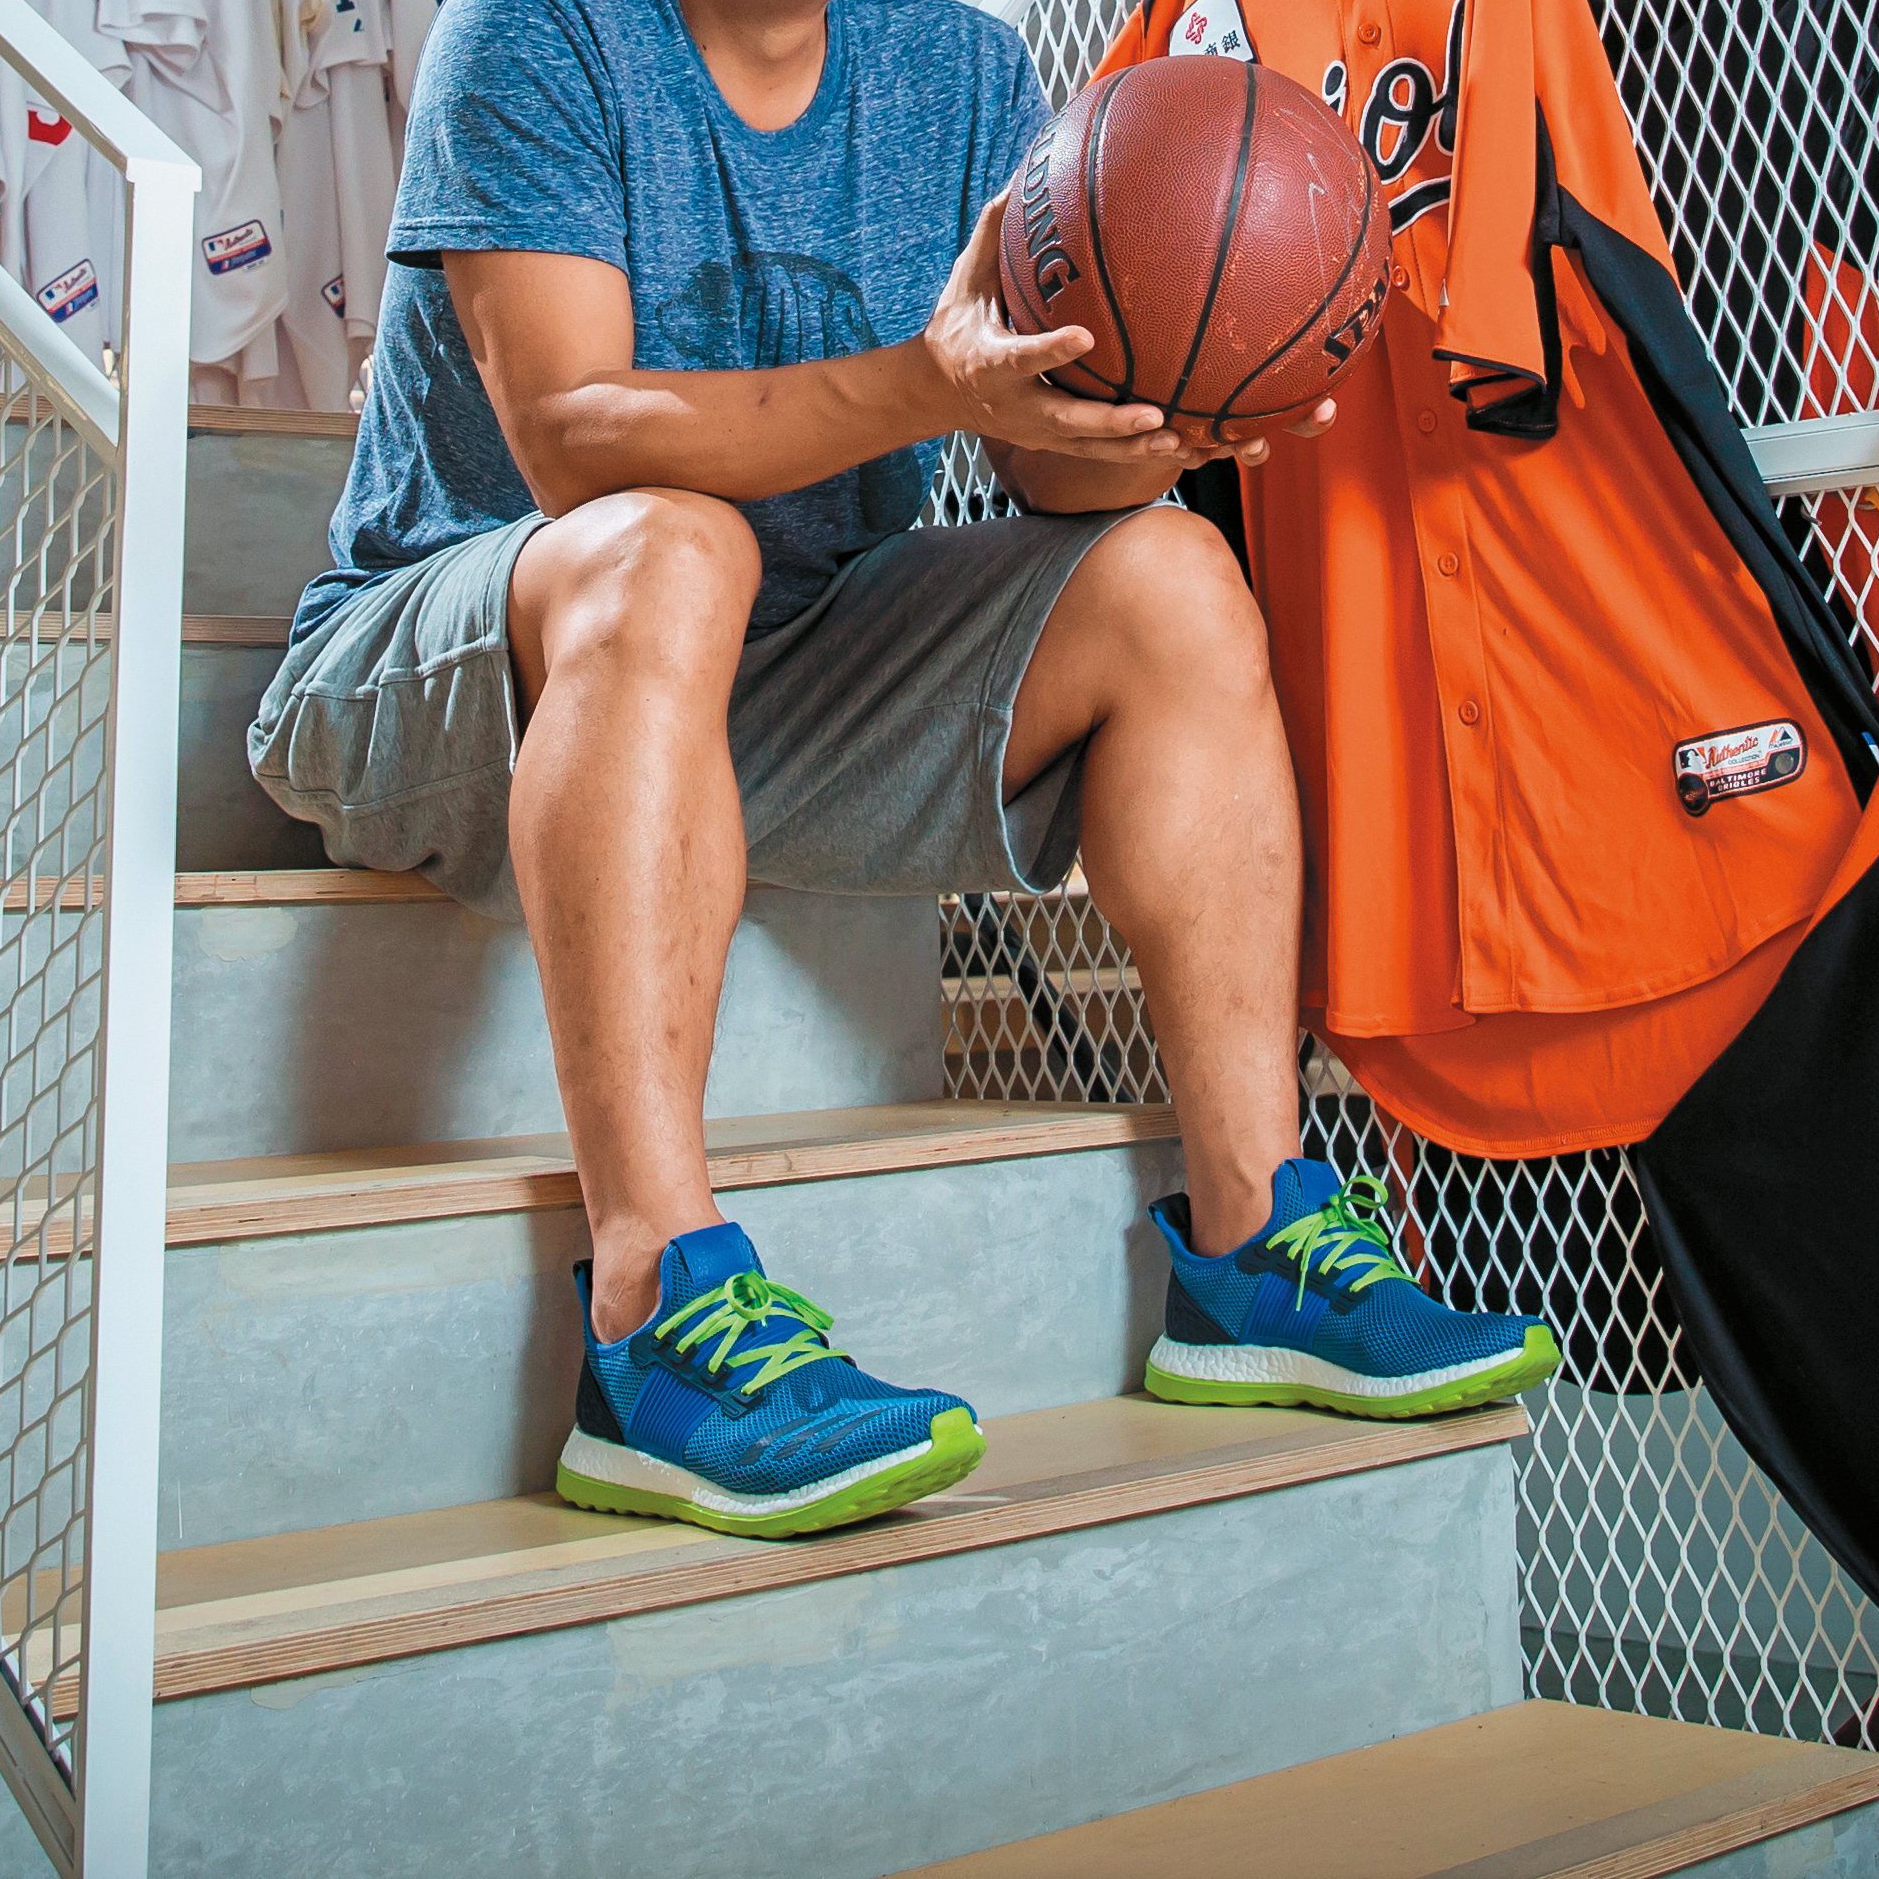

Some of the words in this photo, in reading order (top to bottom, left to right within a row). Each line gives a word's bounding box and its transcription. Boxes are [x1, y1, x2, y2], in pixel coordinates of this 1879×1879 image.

[1706, 736, 1759, 769] Authentic
[1709, 768, 1767, 788] BALTIMORE
[1718, 777, 1760, 791] ORIOLES
